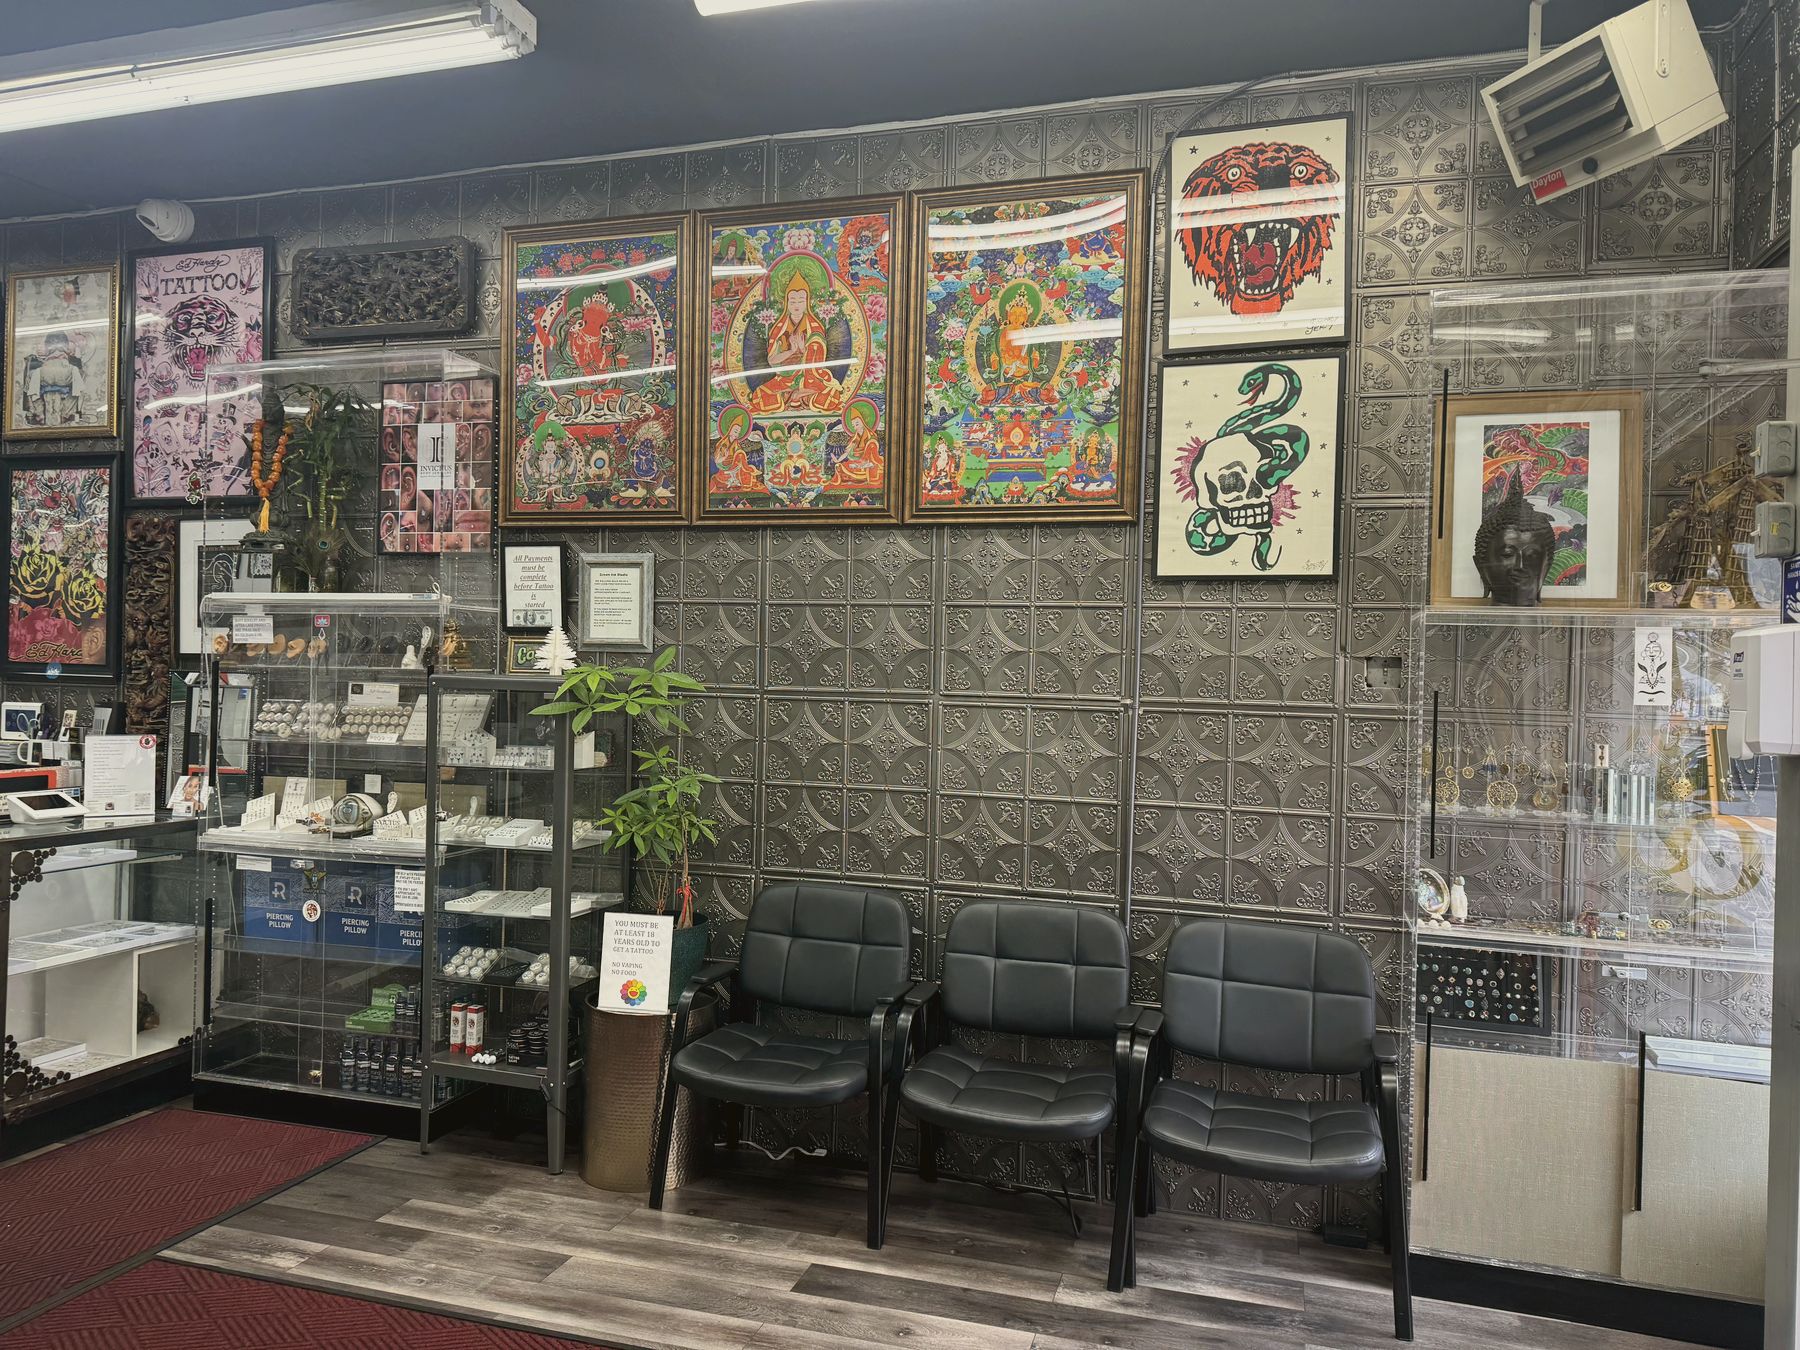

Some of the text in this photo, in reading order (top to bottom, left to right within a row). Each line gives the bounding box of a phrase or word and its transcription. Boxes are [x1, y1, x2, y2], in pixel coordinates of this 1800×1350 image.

[1532, 171, 1562, 189] Dayton
[183, 254, 231, 273] Hardy
[160, 272, 238, 296] TATTOO
[520, 573, 547, 581] complete
[514, 582, 532, 590] before
[25, 643, 48, 659] Ed
[517, 647, 535, 665] Ca
[266, 912, 294, 921] PIERCING
[268, 920, 292, 928] PILLOW
[341, 917, 370, 927] PIERCING
[615, 919, 659, 929] YOU MUST BE
[344, 926, 368, 934] PILLOW
[400, 929, 423, 938] PIERCI
[624, 929, 645, 937] LEAST
[402, 938, 423, 947] PILLO
[614, 938, 635, 946] YEARS
[636, 939, 650, 947] OLD
[630, 947, 654, 955] TATTOO
